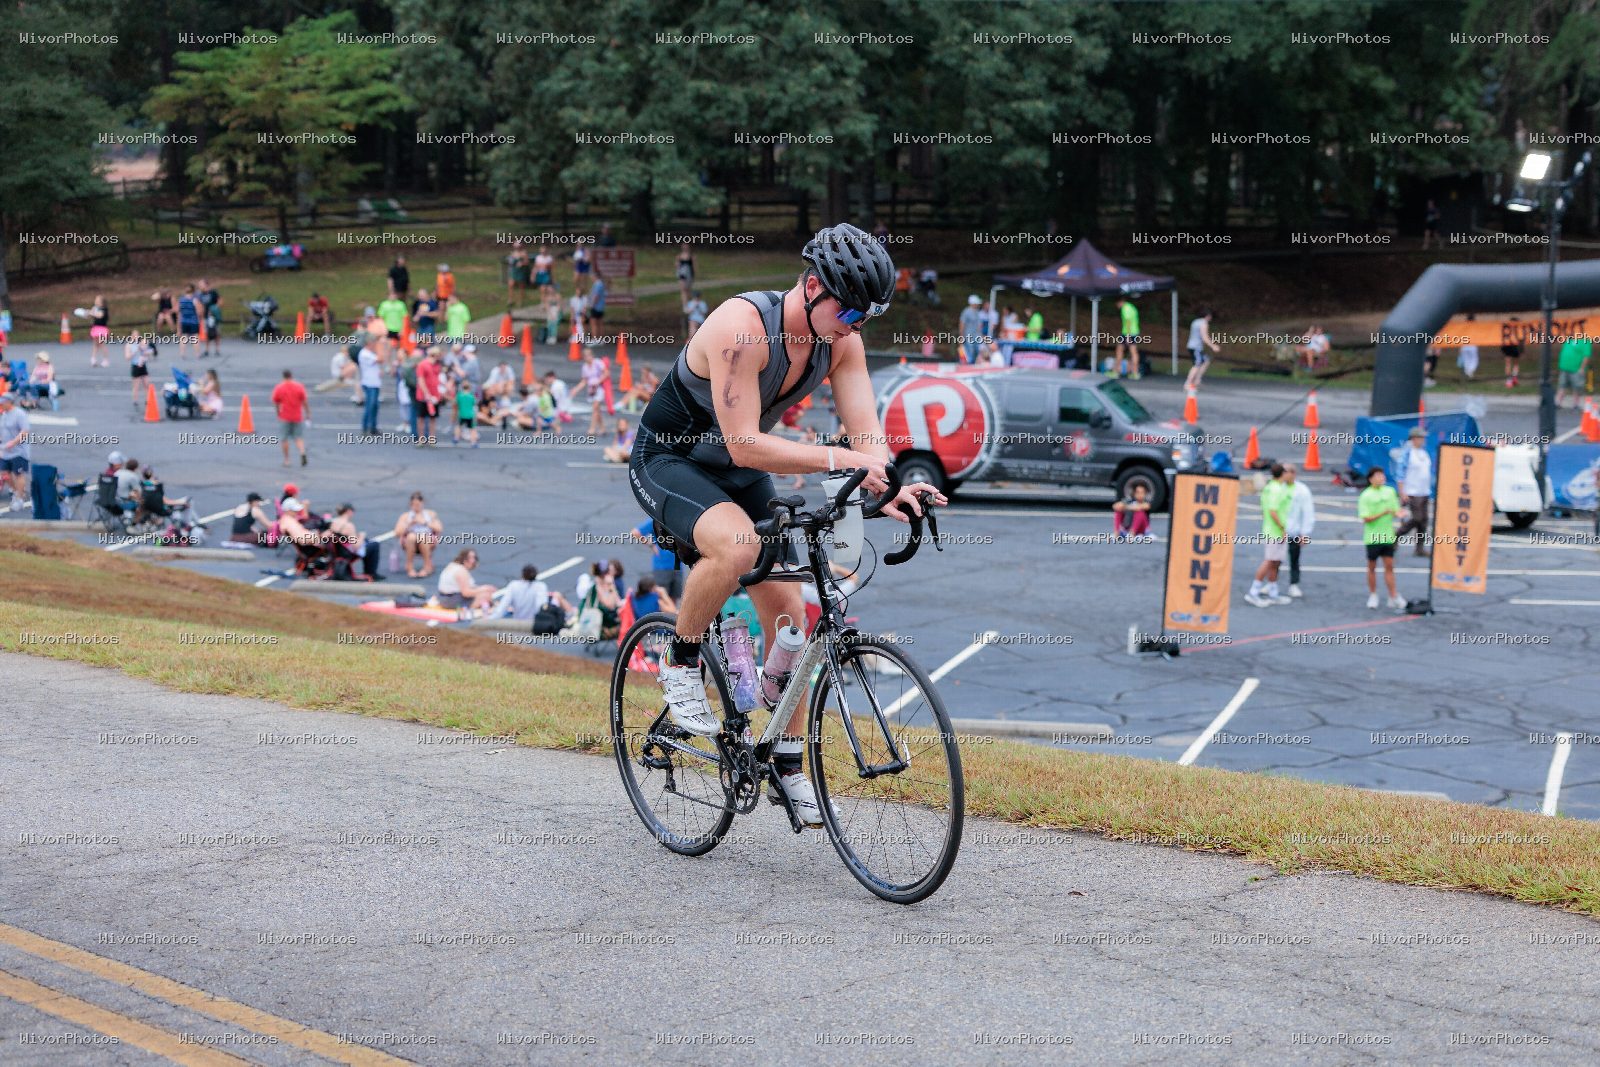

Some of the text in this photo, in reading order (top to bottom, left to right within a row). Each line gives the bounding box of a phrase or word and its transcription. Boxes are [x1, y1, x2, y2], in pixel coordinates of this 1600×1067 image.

[902, 384, 966, 450] P
[1189, 483, 1220, 606] MOUNT
[1455, 454, 1474, 568] DISMOUNT
